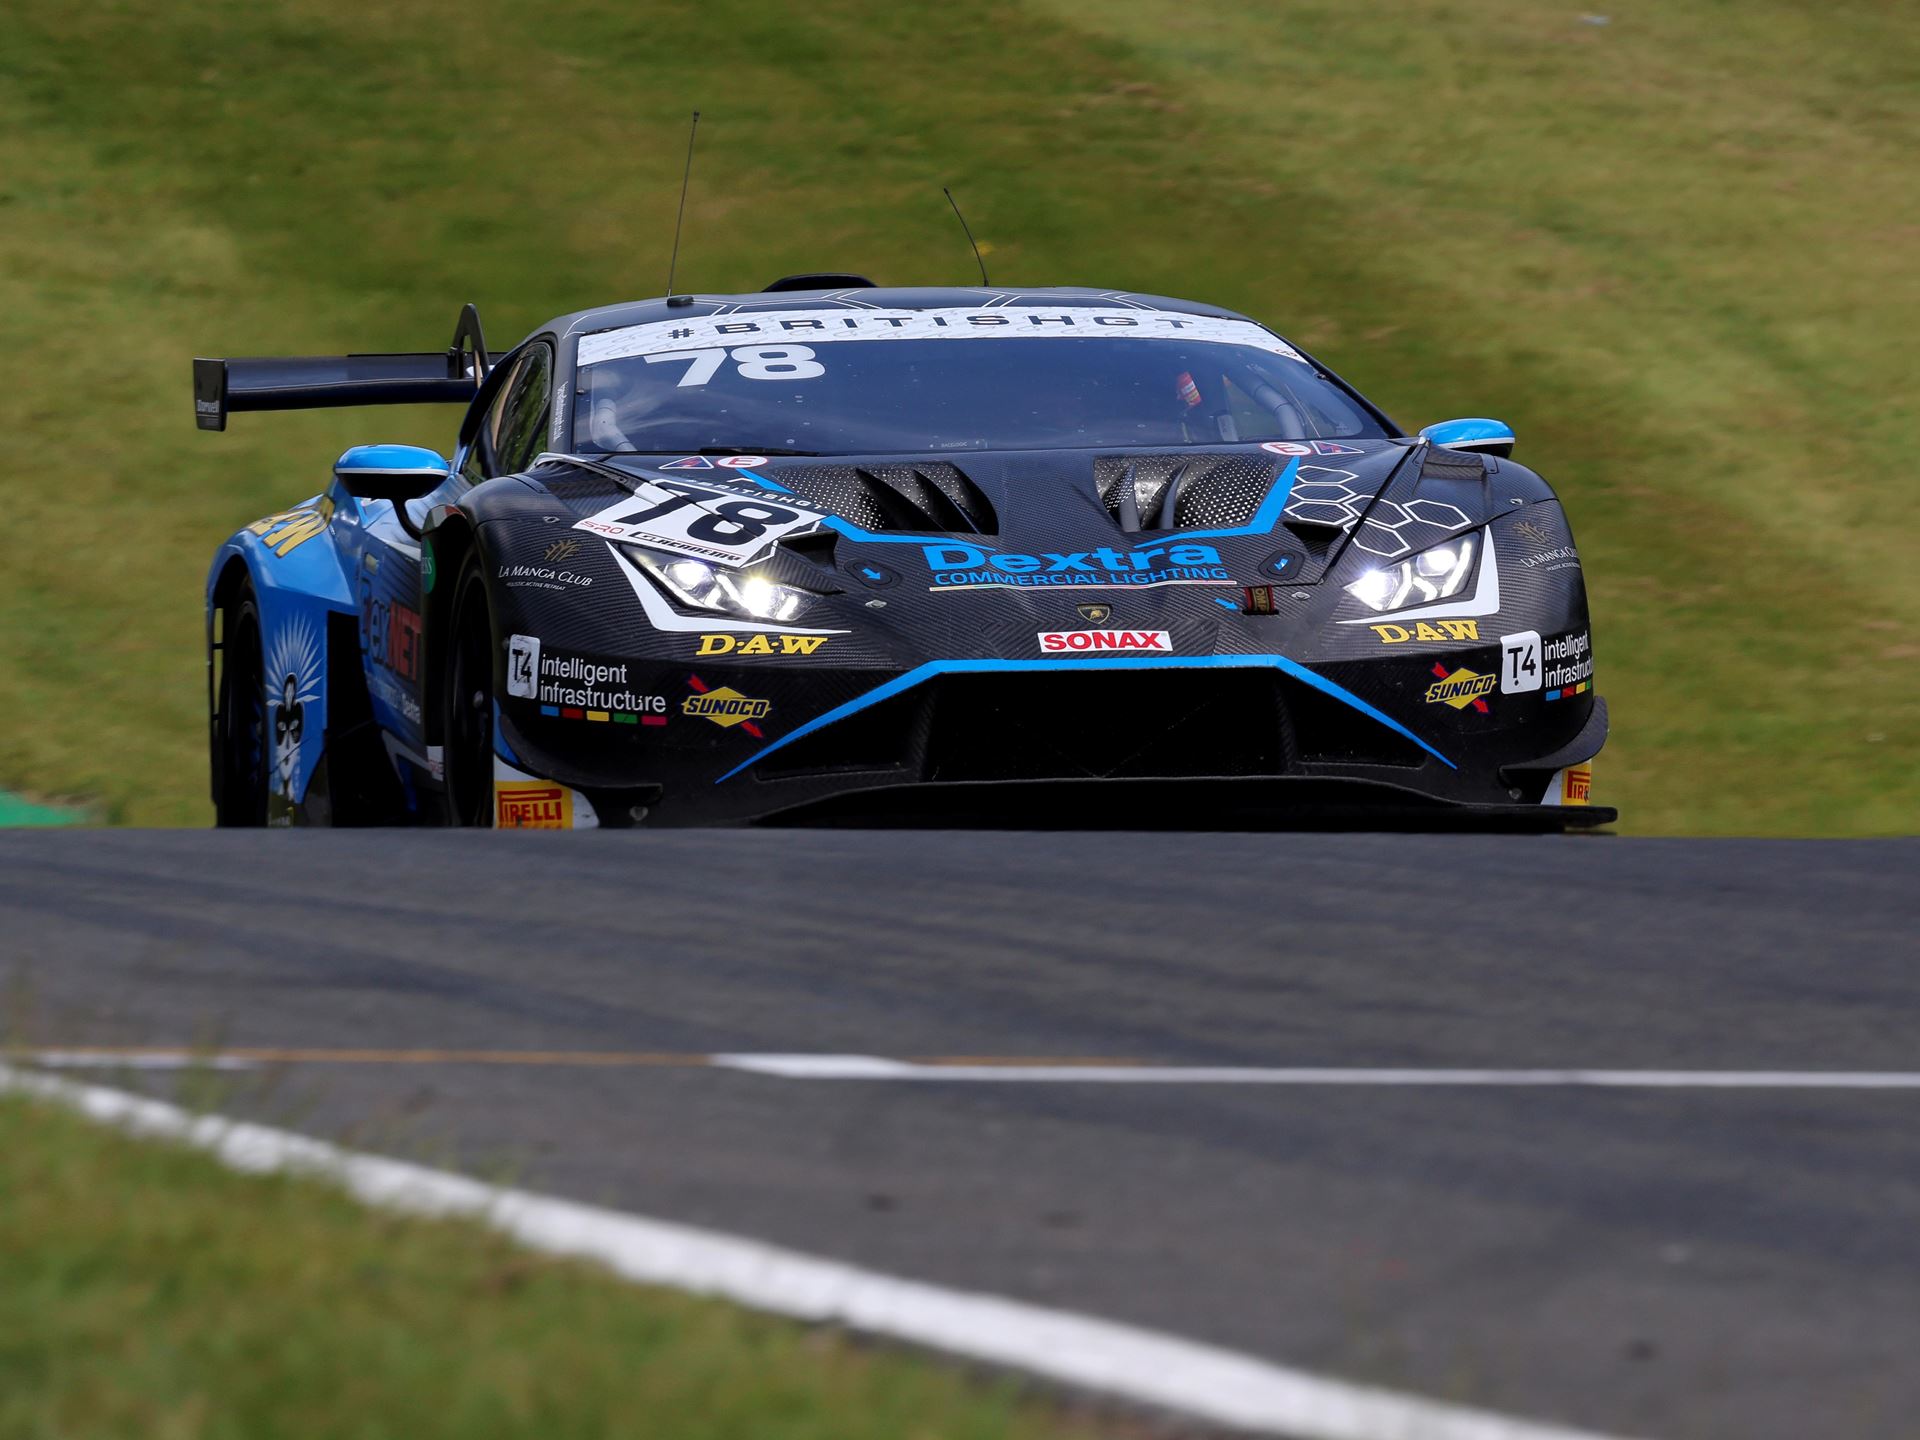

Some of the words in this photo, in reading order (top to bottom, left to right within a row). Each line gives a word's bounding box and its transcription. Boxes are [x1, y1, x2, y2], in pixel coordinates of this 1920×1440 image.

[667, 314, 1195, 340] #BRITISHGT
[643, 344, 826, 387] 78
[580, 519, 625, 535] SRO
[613, 480, 801, 546] 78
[922, 543, 1223, 573] Dextra
[498, 565, 509, 578] LA
[511, 565, 556, 580] MANGA
[557, 571, 593, 586] CLUB
[934, 572, 1108, 586] COMMERCIAL
[1111, 567, 1229, 586] LIGHTING
[1043, 632, 1163, 651] SONAX
[1544, 630, 1589, 660] intelligent
[511, 647, 533, 682] T4
[541, 653, 627, 686] intelligent
[1507, 644, 1537, 684] T4
[540, 680, 667, 713] infrastructure
[1428, 675, 1495, 701] SUNOCO
[686, 695, 768, 717] SUNOCO
